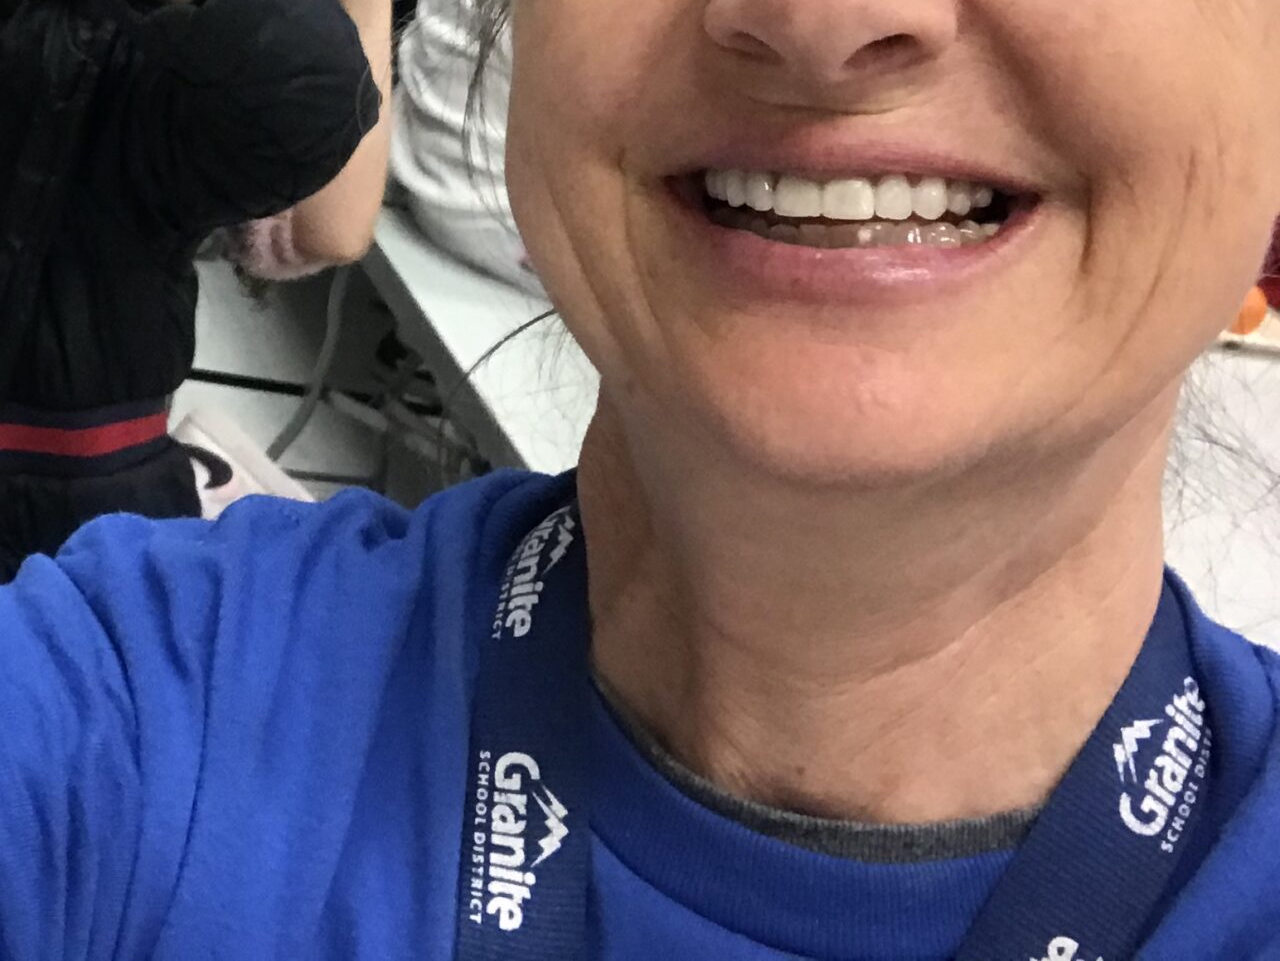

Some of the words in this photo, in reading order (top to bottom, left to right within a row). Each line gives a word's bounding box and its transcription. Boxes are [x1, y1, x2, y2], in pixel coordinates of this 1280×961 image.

[474, 749, 491, 825] SCHOOL
[1119, 676, 1206, 836] Granite
[486, 752, 541, 931] Granite
[1160, 781, 1200, 854] SCHOOL
[469, 832, 486, 925] DISTRICT
